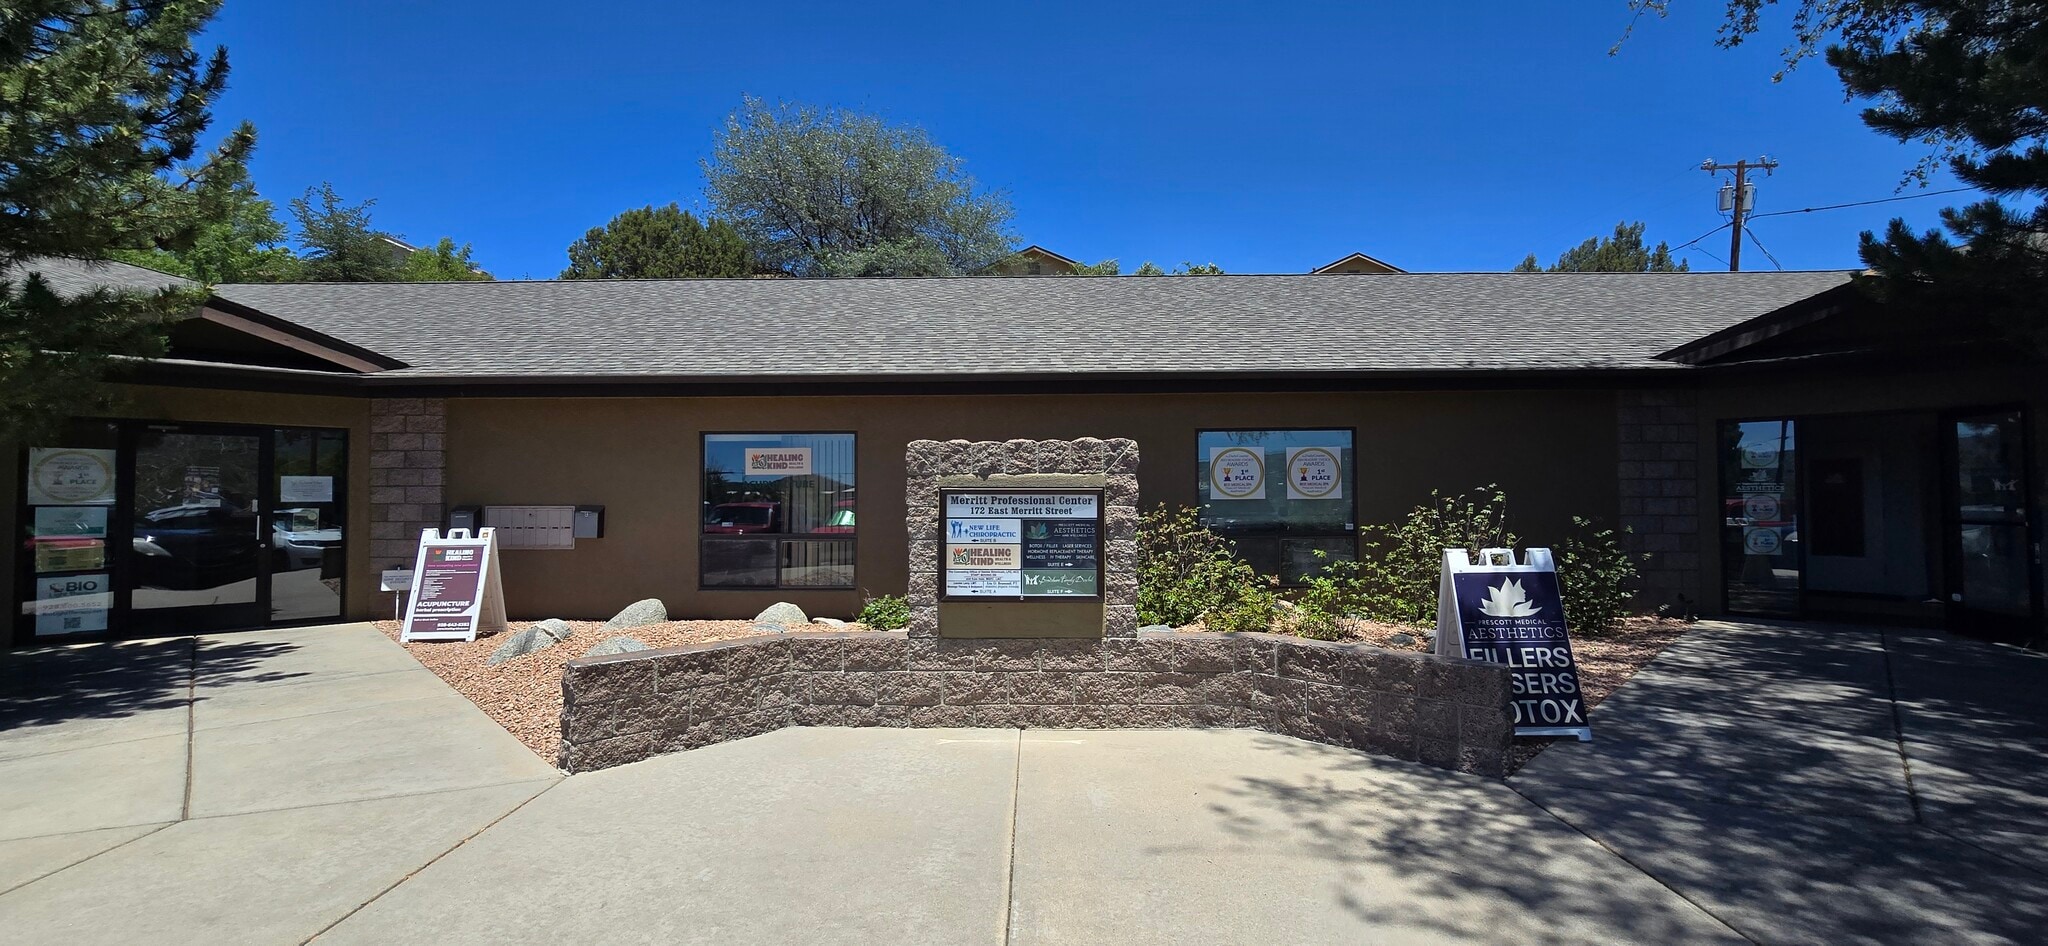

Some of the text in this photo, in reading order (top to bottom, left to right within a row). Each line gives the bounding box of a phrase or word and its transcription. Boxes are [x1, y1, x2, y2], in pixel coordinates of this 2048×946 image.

[767, 453, 804, 462] HEALING
[767, 462, 788, 470] KIND
[950, 495, 1093, 505] Merritt Professional Center
[970, 506, 1073, 515] 172 East Merritt Street
[970, 548, 1012, 557] HEALING
[970, 557, 994, 566] KIND
[66, 580, 98, 592] BIO
[1468, 626, 1564, 639] AESTHETICS
[1511, 672, 1577, 695] SERS
